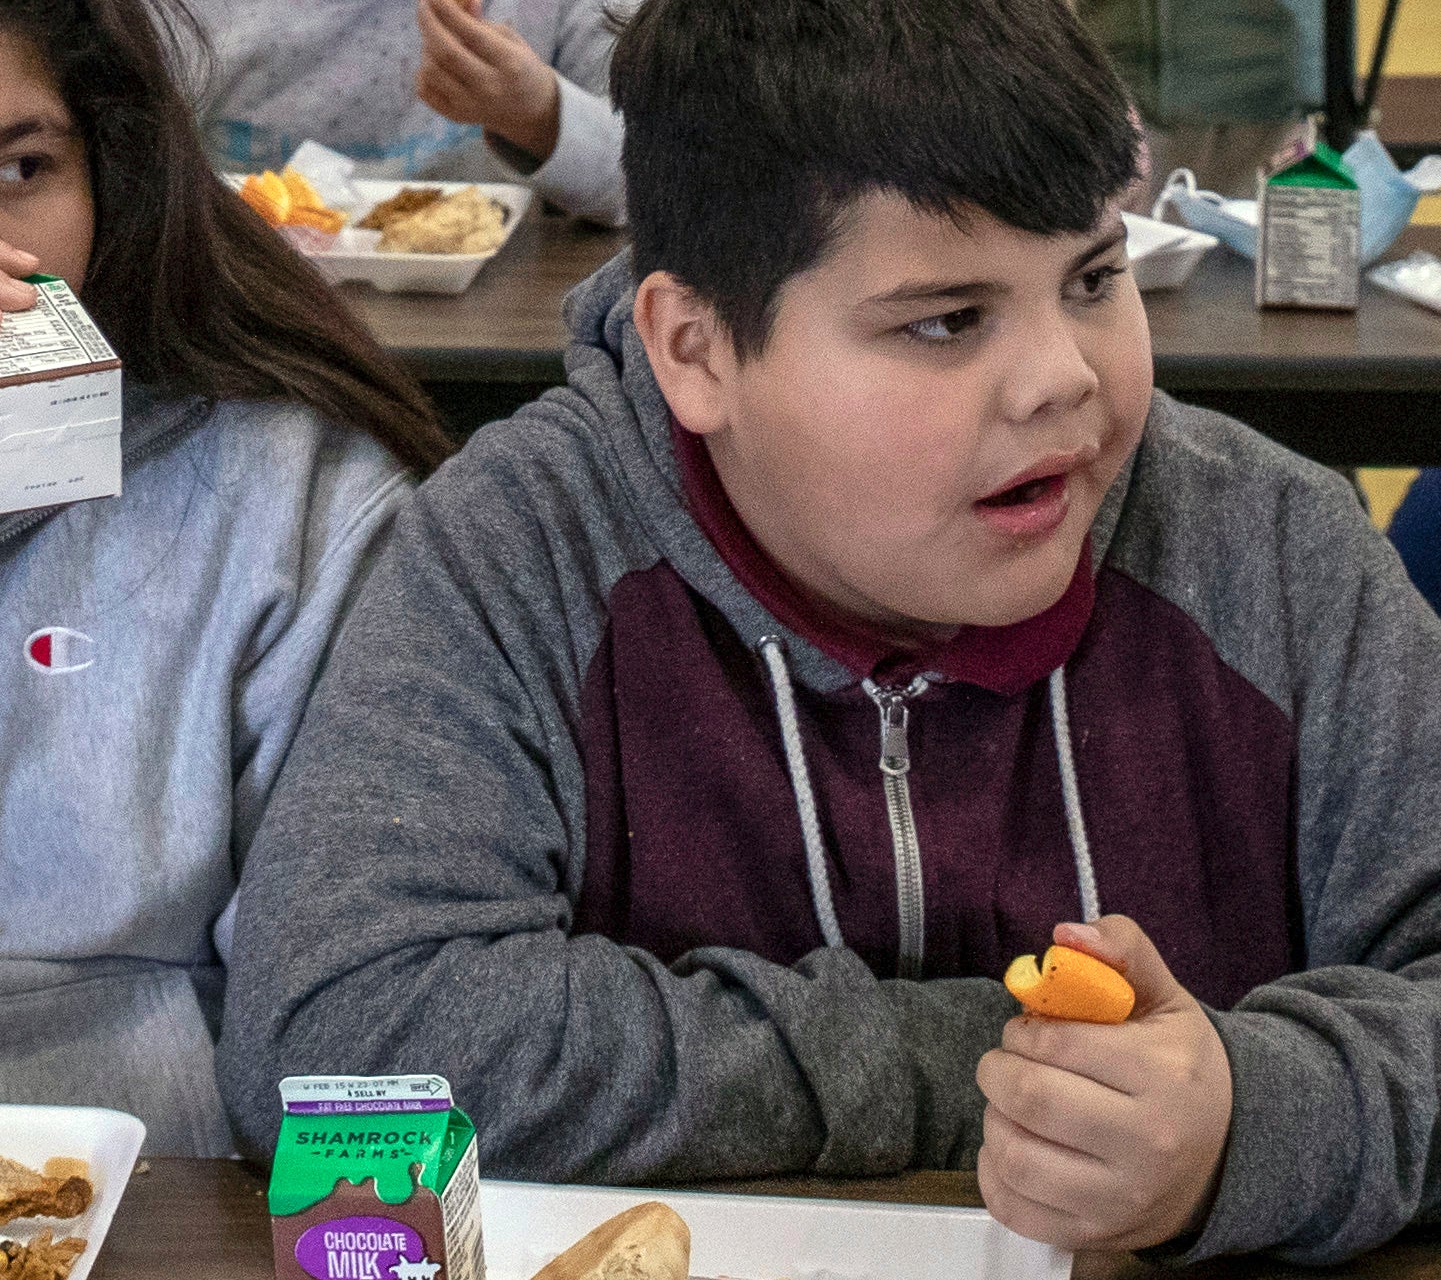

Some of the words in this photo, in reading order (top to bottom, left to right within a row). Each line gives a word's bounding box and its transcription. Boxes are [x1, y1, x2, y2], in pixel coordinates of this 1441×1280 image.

[296, 1132, 432, 1145] SHAMROCK
[325, 1149, 399, 1159] FARMS
[324, 1231, 407, 1251] CHOCOLATE
[327, 1251, 382, 1280] MILK
